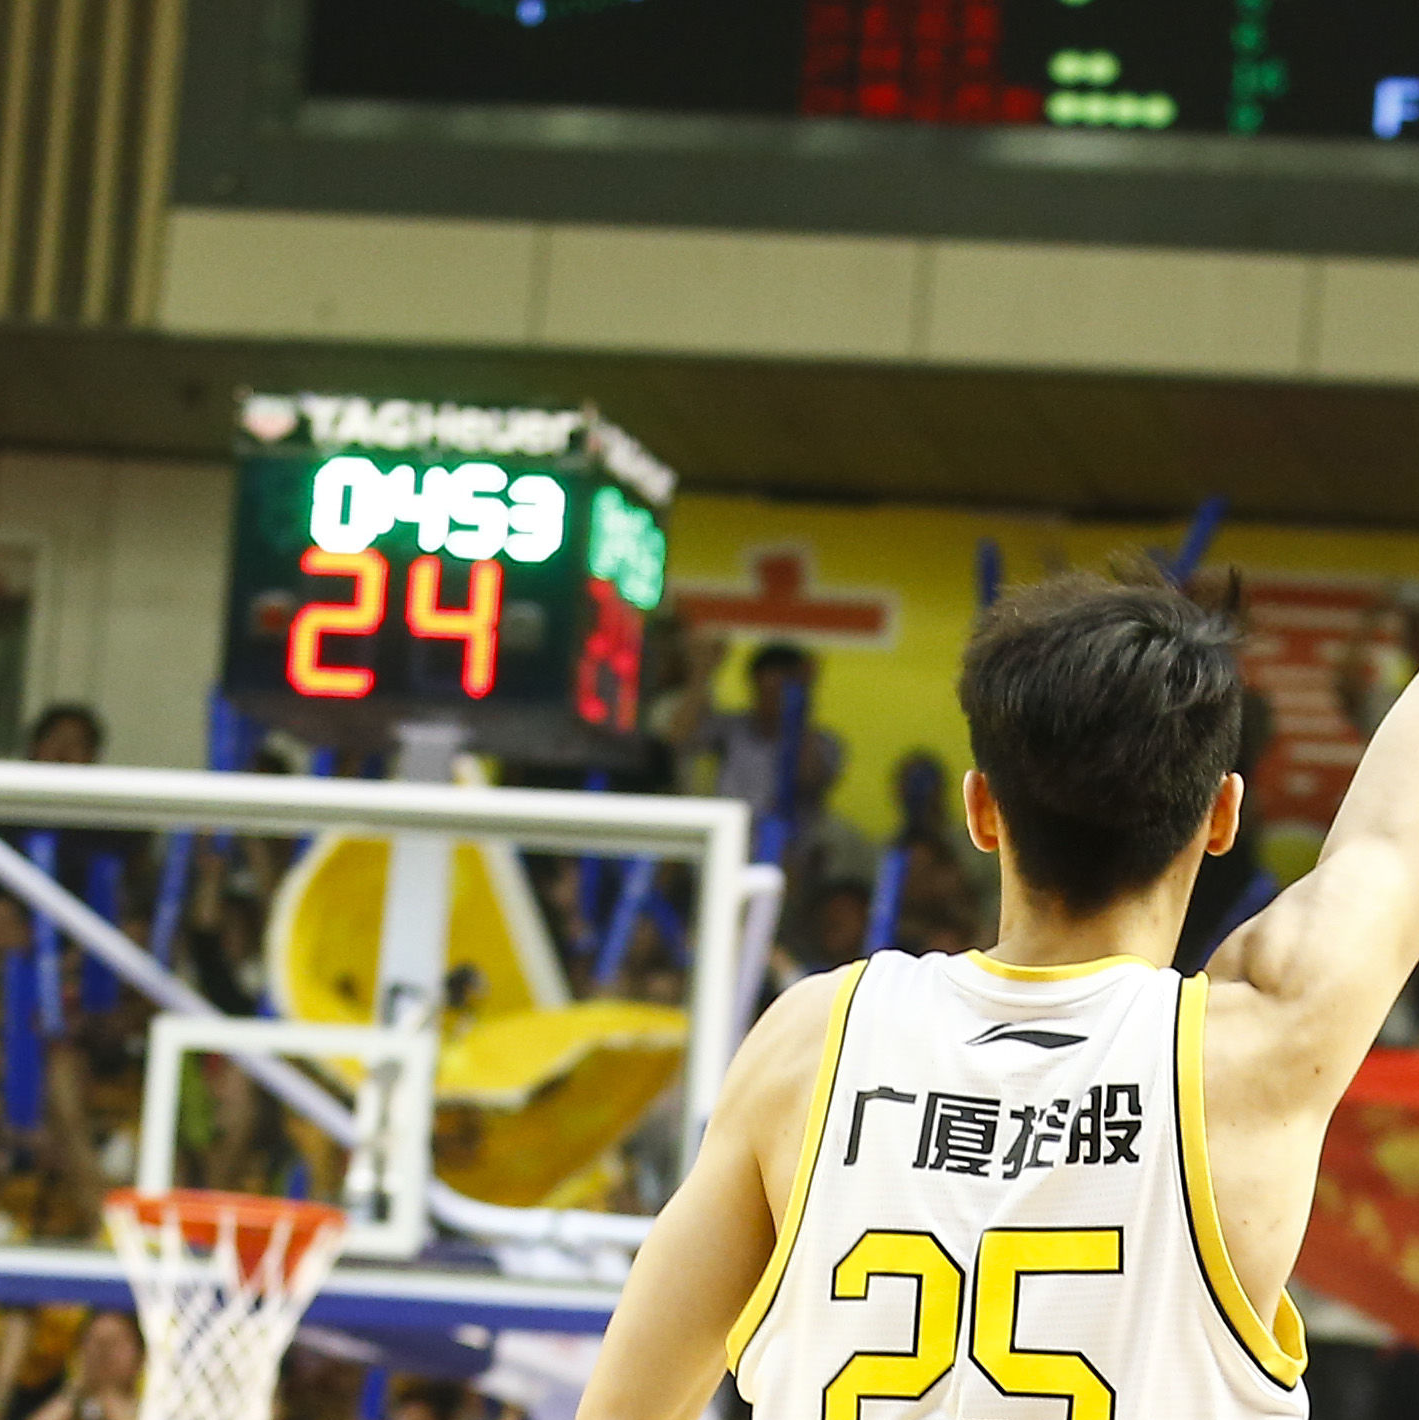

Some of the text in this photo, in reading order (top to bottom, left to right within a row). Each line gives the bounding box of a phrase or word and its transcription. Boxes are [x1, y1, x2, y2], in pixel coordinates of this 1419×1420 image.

[286, 545, 502, 699] 24
[844, 1083, 1143, 1179] 广厦控股
